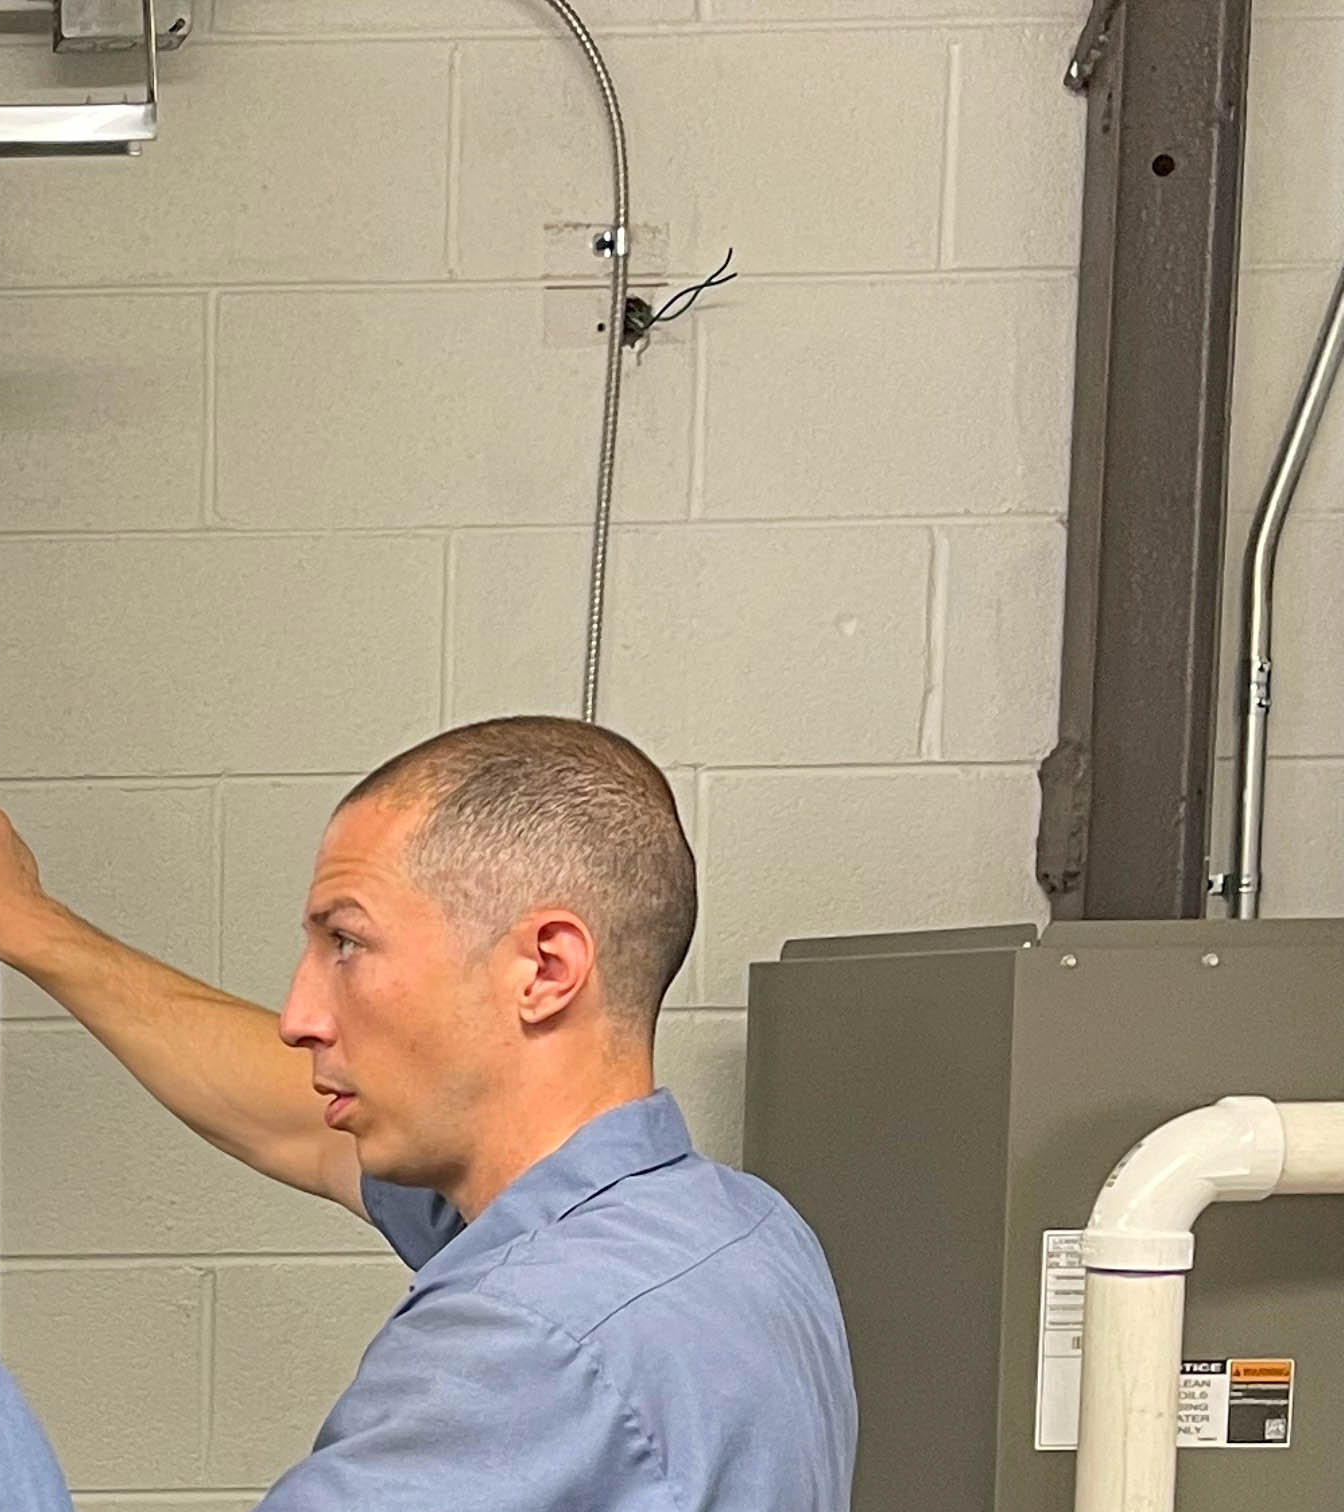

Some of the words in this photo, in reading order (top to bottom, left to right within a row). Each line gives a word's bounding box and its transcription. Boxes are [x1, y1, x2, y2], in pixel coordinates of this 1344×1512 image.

[1180, 1362, 1222, 1372] TICE
[1180, 1379, 1211, 1388] EAN
[1178, 1403, 1209, 1411] SING
[1177, 1414, 1210, 1423] ATER
[1177, 1426, 1201, 1434] NLY
